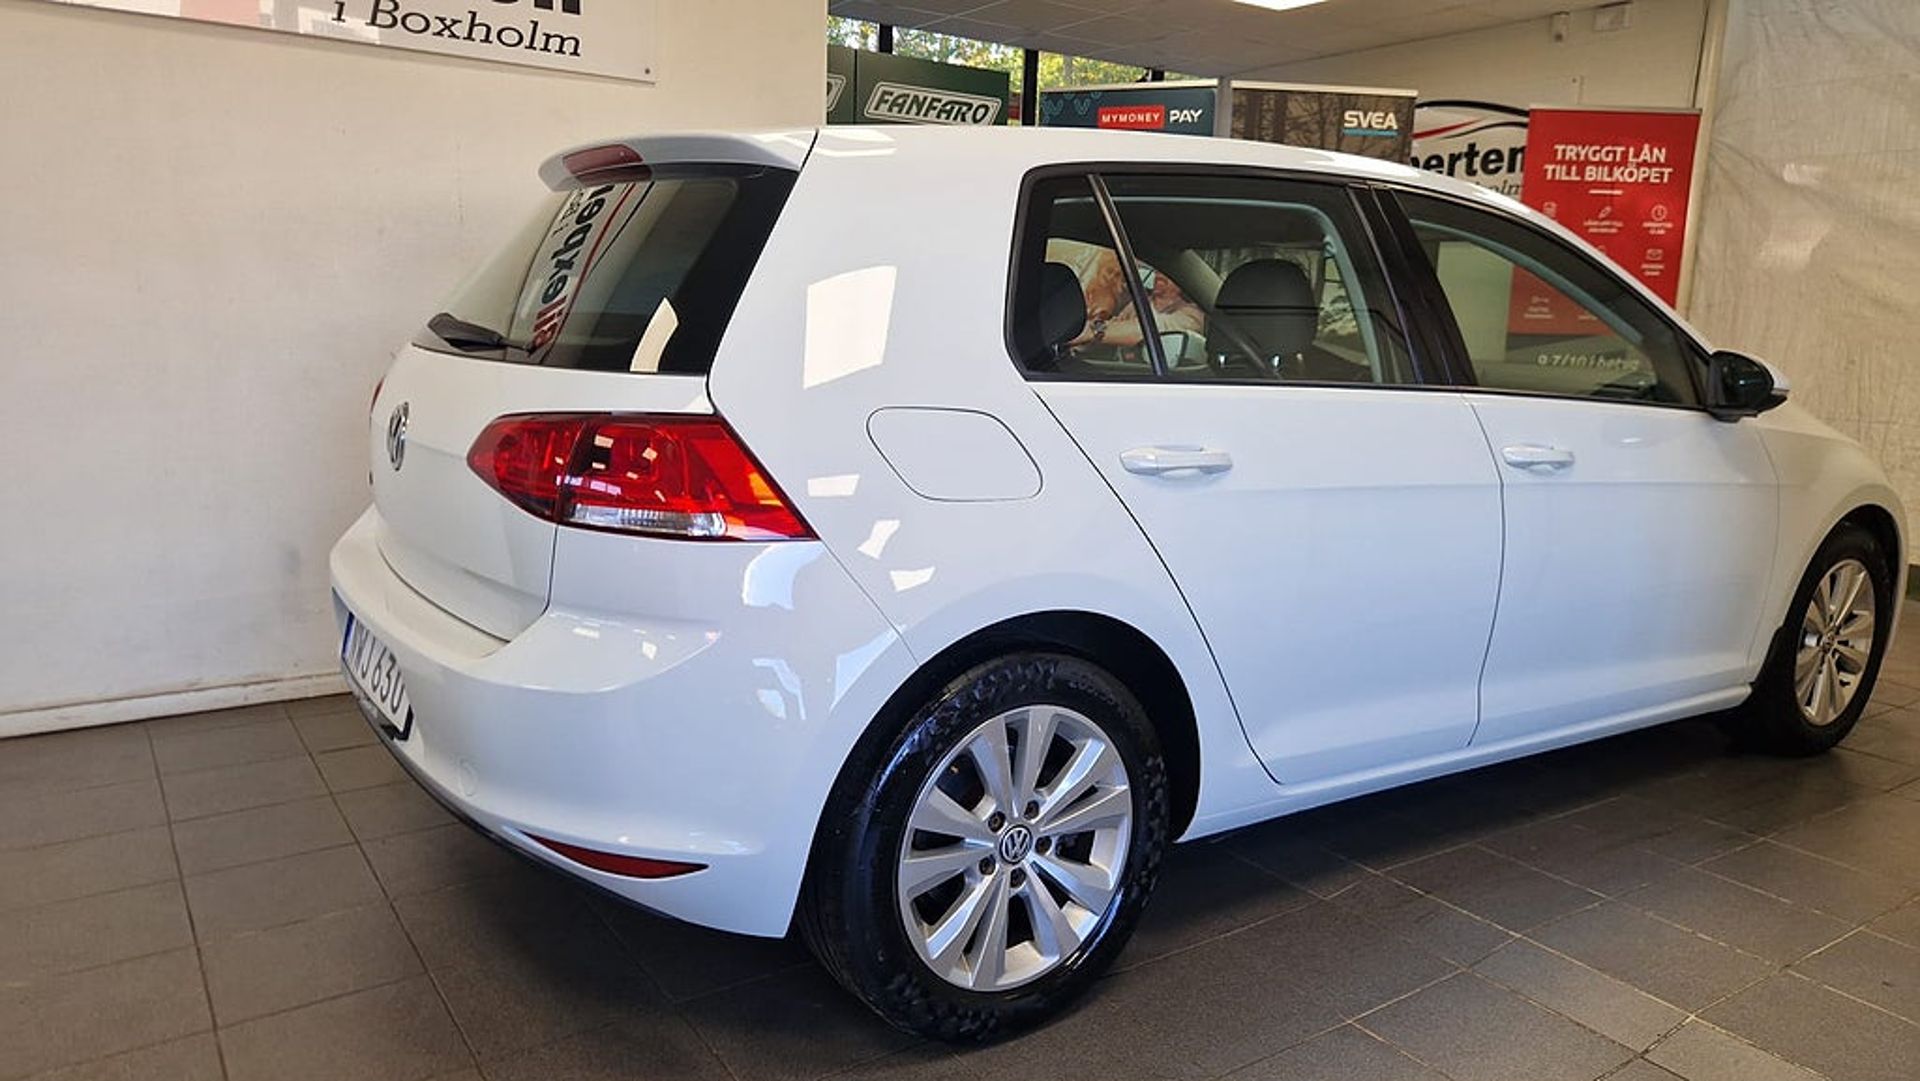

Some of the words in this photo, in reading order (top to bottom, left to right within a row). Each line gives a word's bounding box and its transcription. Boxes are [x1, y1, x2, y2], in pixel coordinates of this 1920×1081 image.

[365, 0, 582, 57] Boxholm
[873, 89, 990, 124] FANFARO
[1101, 112, 1161, 124] MYMONEY
[1169, 108, 1203, 124] PAY
[1343, 110, 1399, 130] SVEA
[1554, 144, 1626, 162] TRYGGT
[1627, 143, 1667, 163] LÅN
[1543, 164, 1582, 181] TILL
[1584, 161, 1674, 184] BILKÖPET
